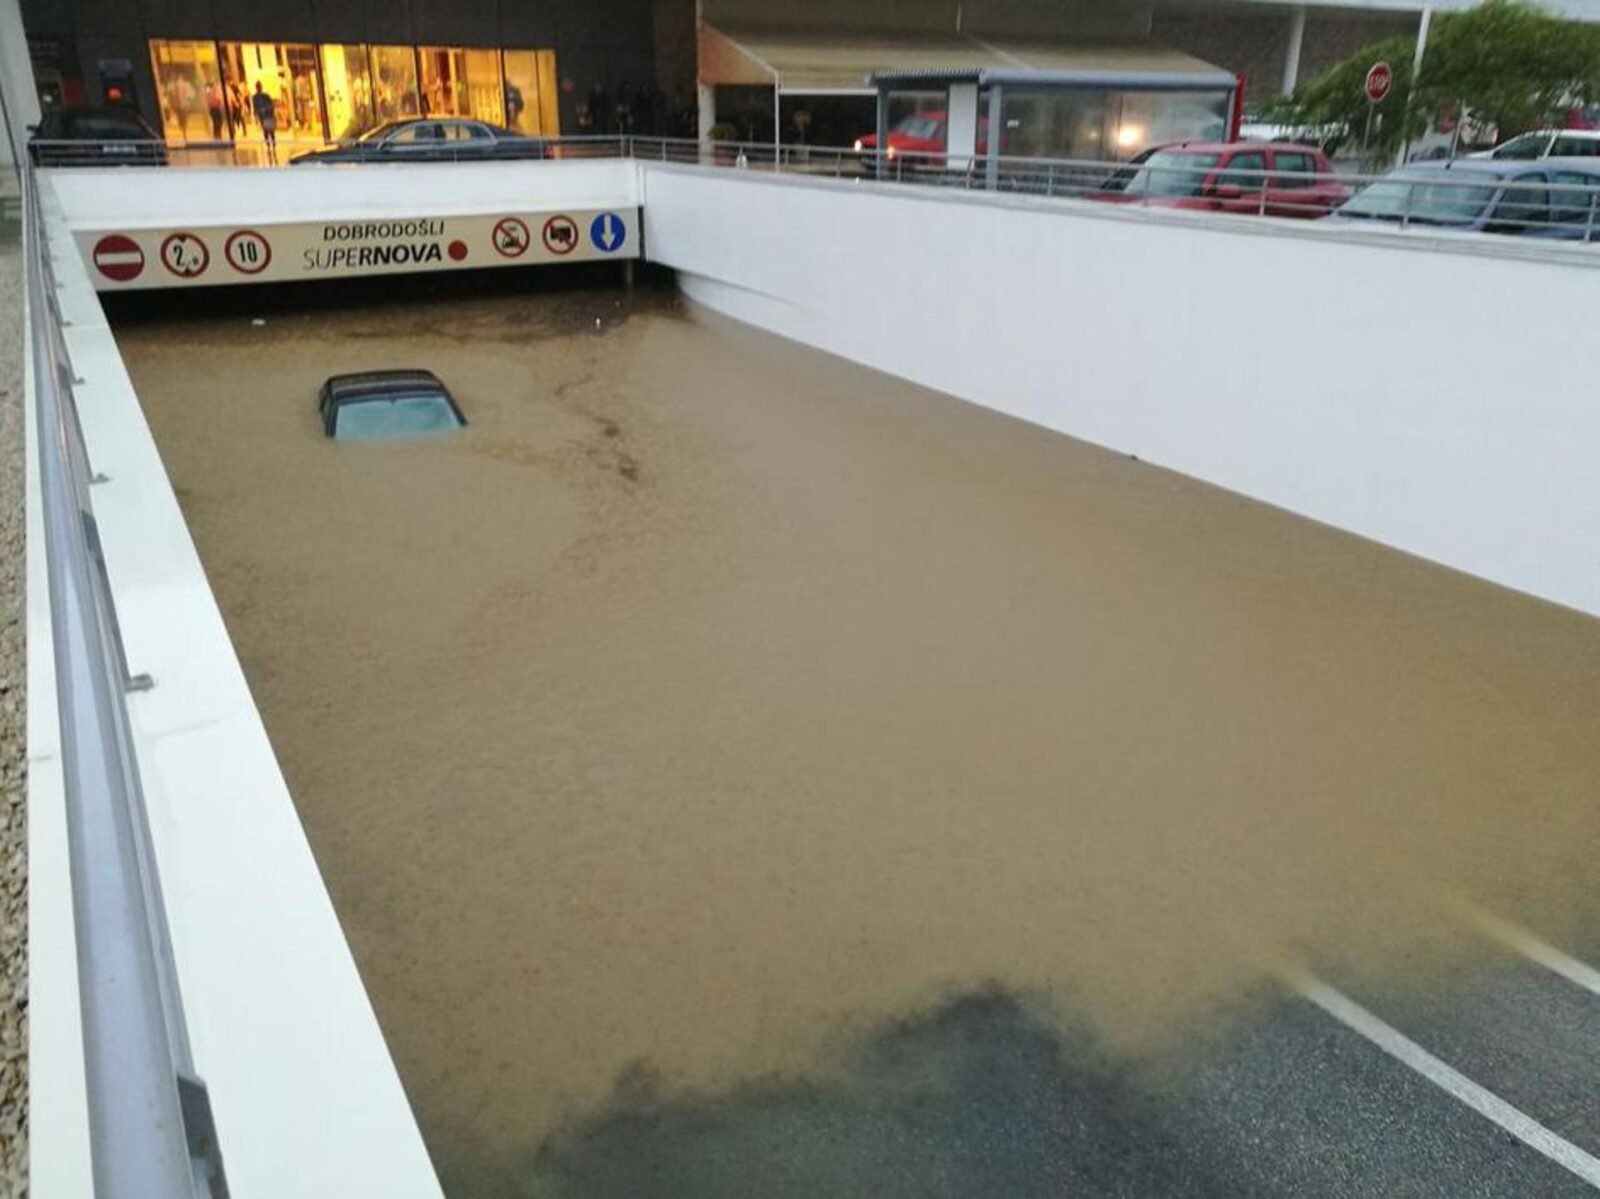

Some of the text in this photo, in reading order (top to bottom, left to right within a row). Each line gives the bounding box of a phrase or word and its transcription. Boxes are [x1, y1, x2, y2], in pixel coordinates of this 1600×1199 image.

[1369, 74, 1388, 90] STOP
[324, 219, 444, 241] DOBRODOŠLI
[238, 241, 257, 263] 10
[304, 243, 443, 270] SUPERNOVA
